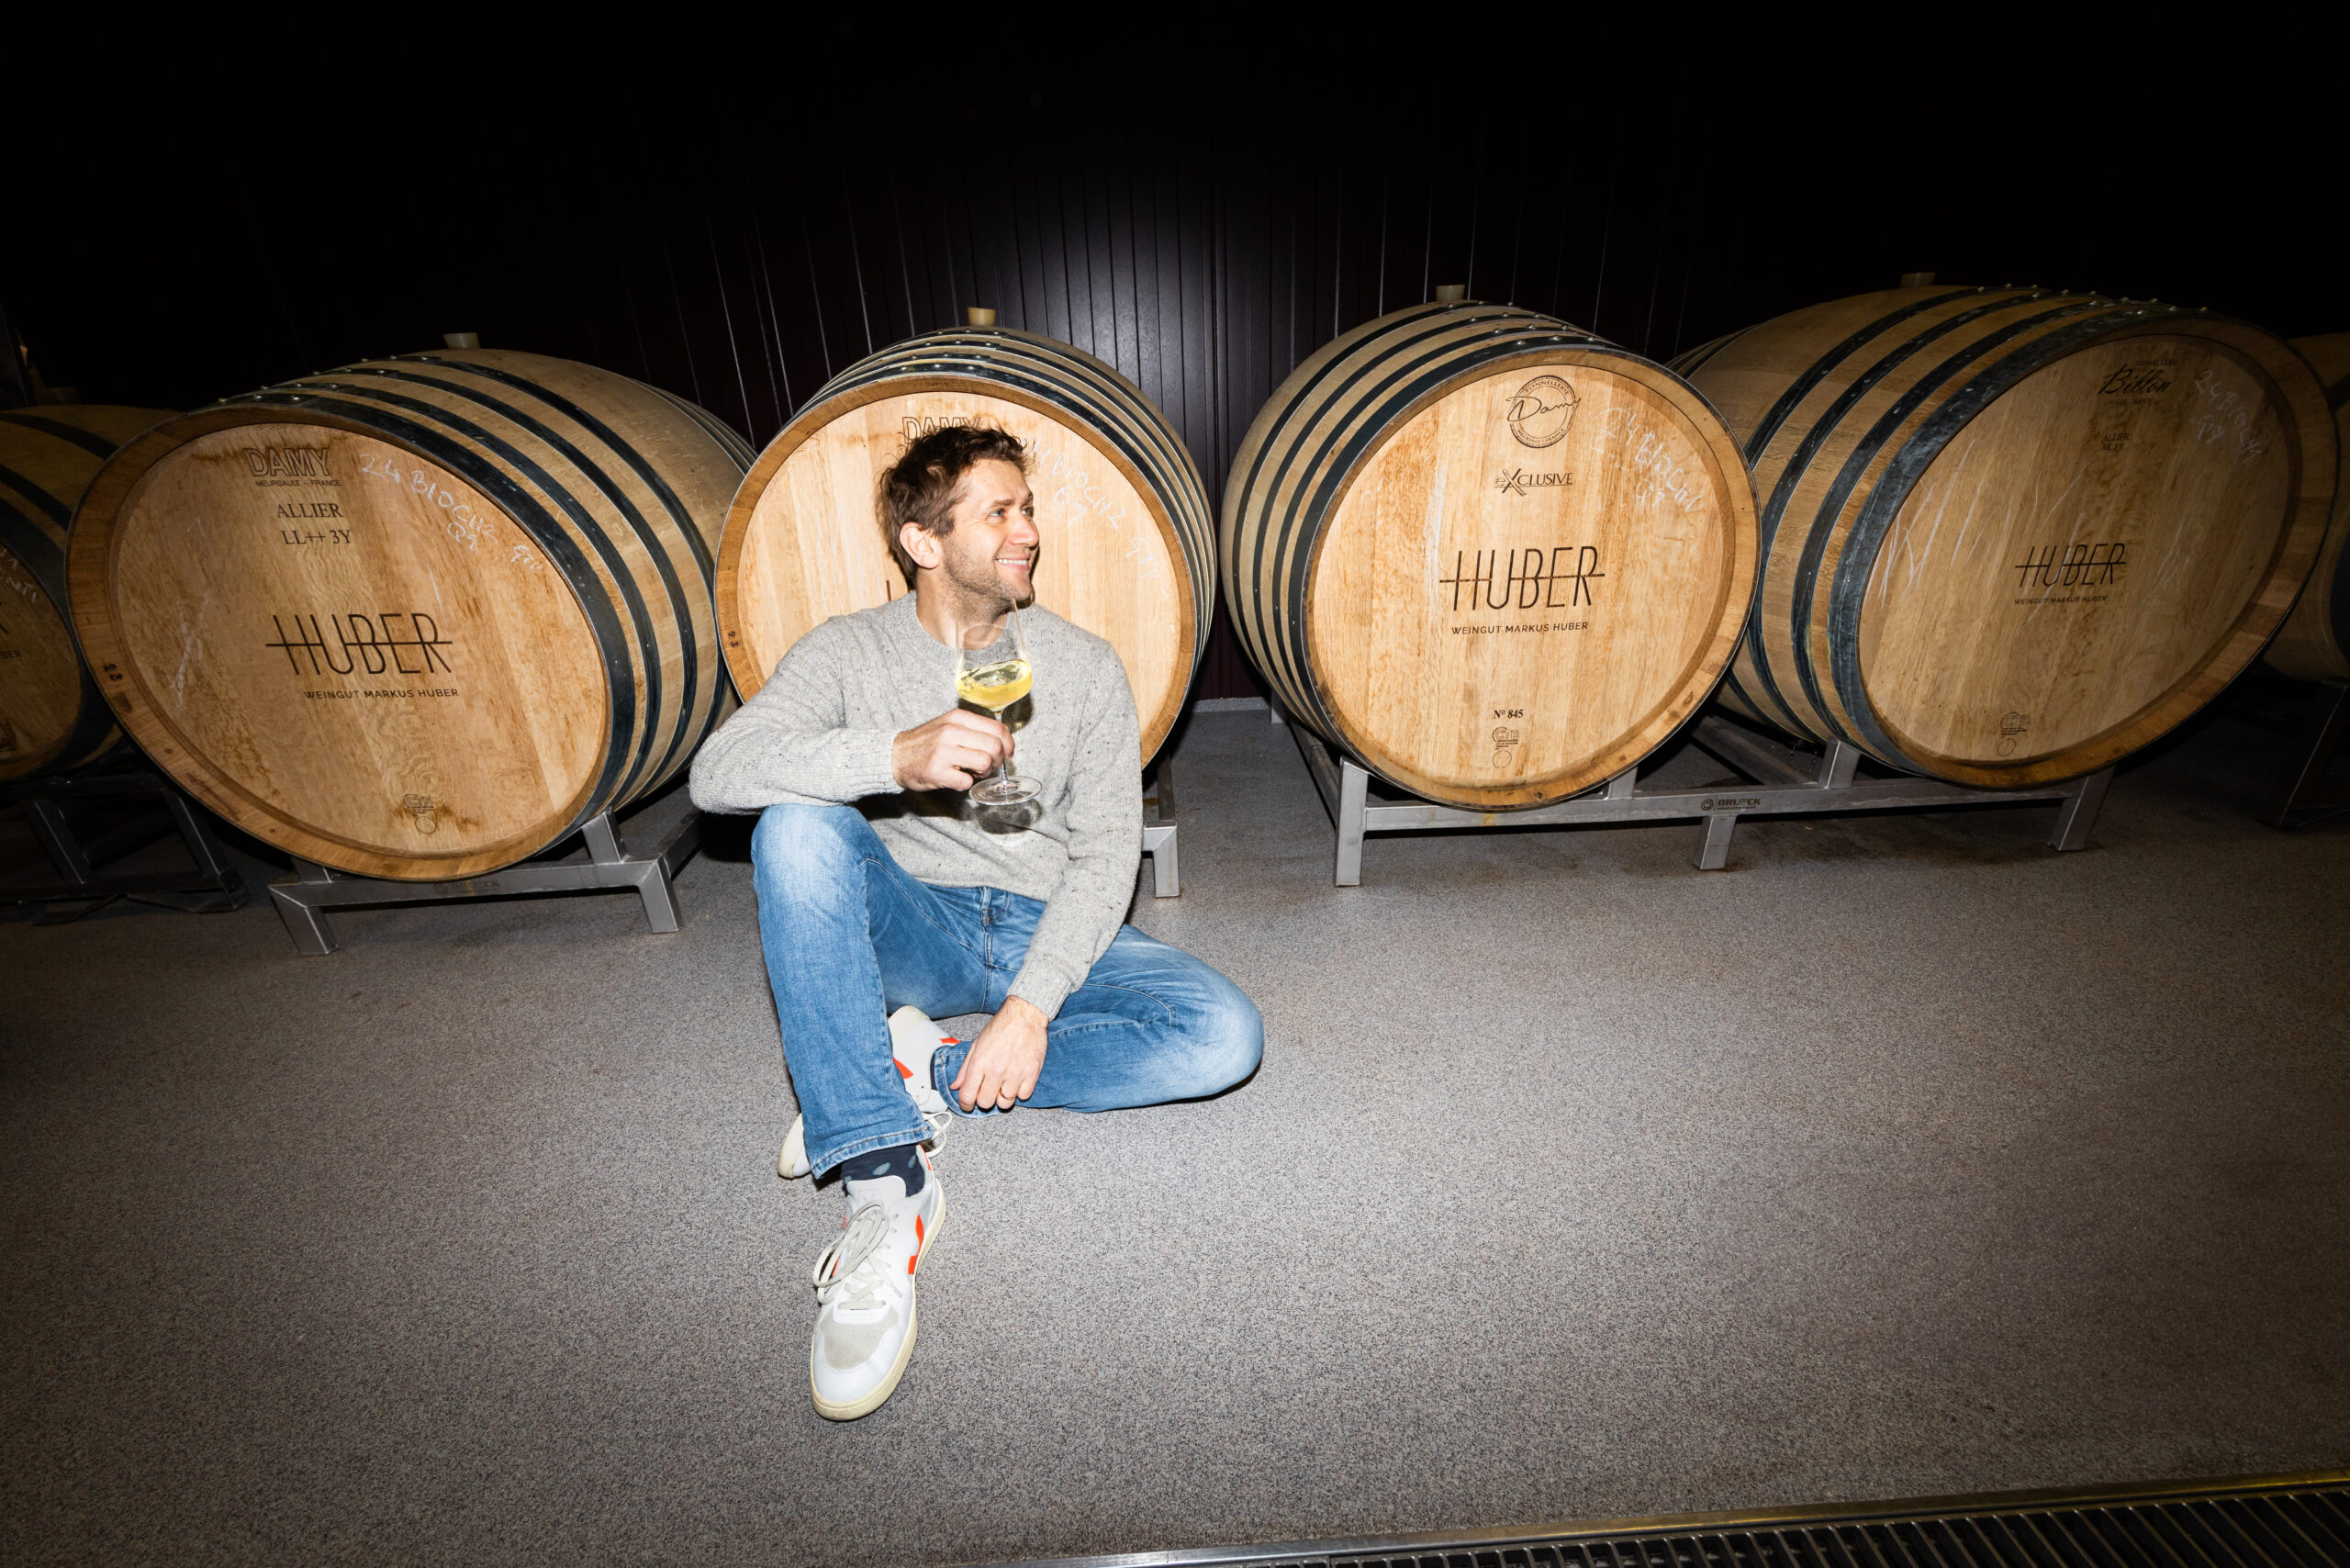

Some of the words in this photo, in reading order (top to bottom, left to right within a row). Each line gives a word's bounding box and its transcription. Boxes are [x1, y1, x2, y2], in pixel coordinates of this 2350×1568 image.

[1525, 379, 1570, 396] TONNELLERIE
[2098, 363, 2172, 396] Billon
[1505, 396, 1582, 429] Damy
[242, 447, 330, 476] DAMY
[360, 454, 399, 483] 24
[277, 502, 344, 519] ALLIER
[279, 530, 326, 544] LL++
[330, 529, 352, 543] 3Y
[2015, 543, 2126, 588] HUBER
[1439, 545, 1605, 611] HUBER
[1451, 625, 1502, 635] WEINGUT
[1505, 623, 1550, 633] MARKUS
[1553, 622, 1588, 632] HUBER
[264, 612, 453, 675] HUBER
[303, 690, 359, 700] WEINGUT
[364, 689, 414, 699] MARKUS
[418, 689, 459, 698] HUBER
[1507, 709, 1524, 719] 845
[1718, 797, 1762, 806] DRUECK
